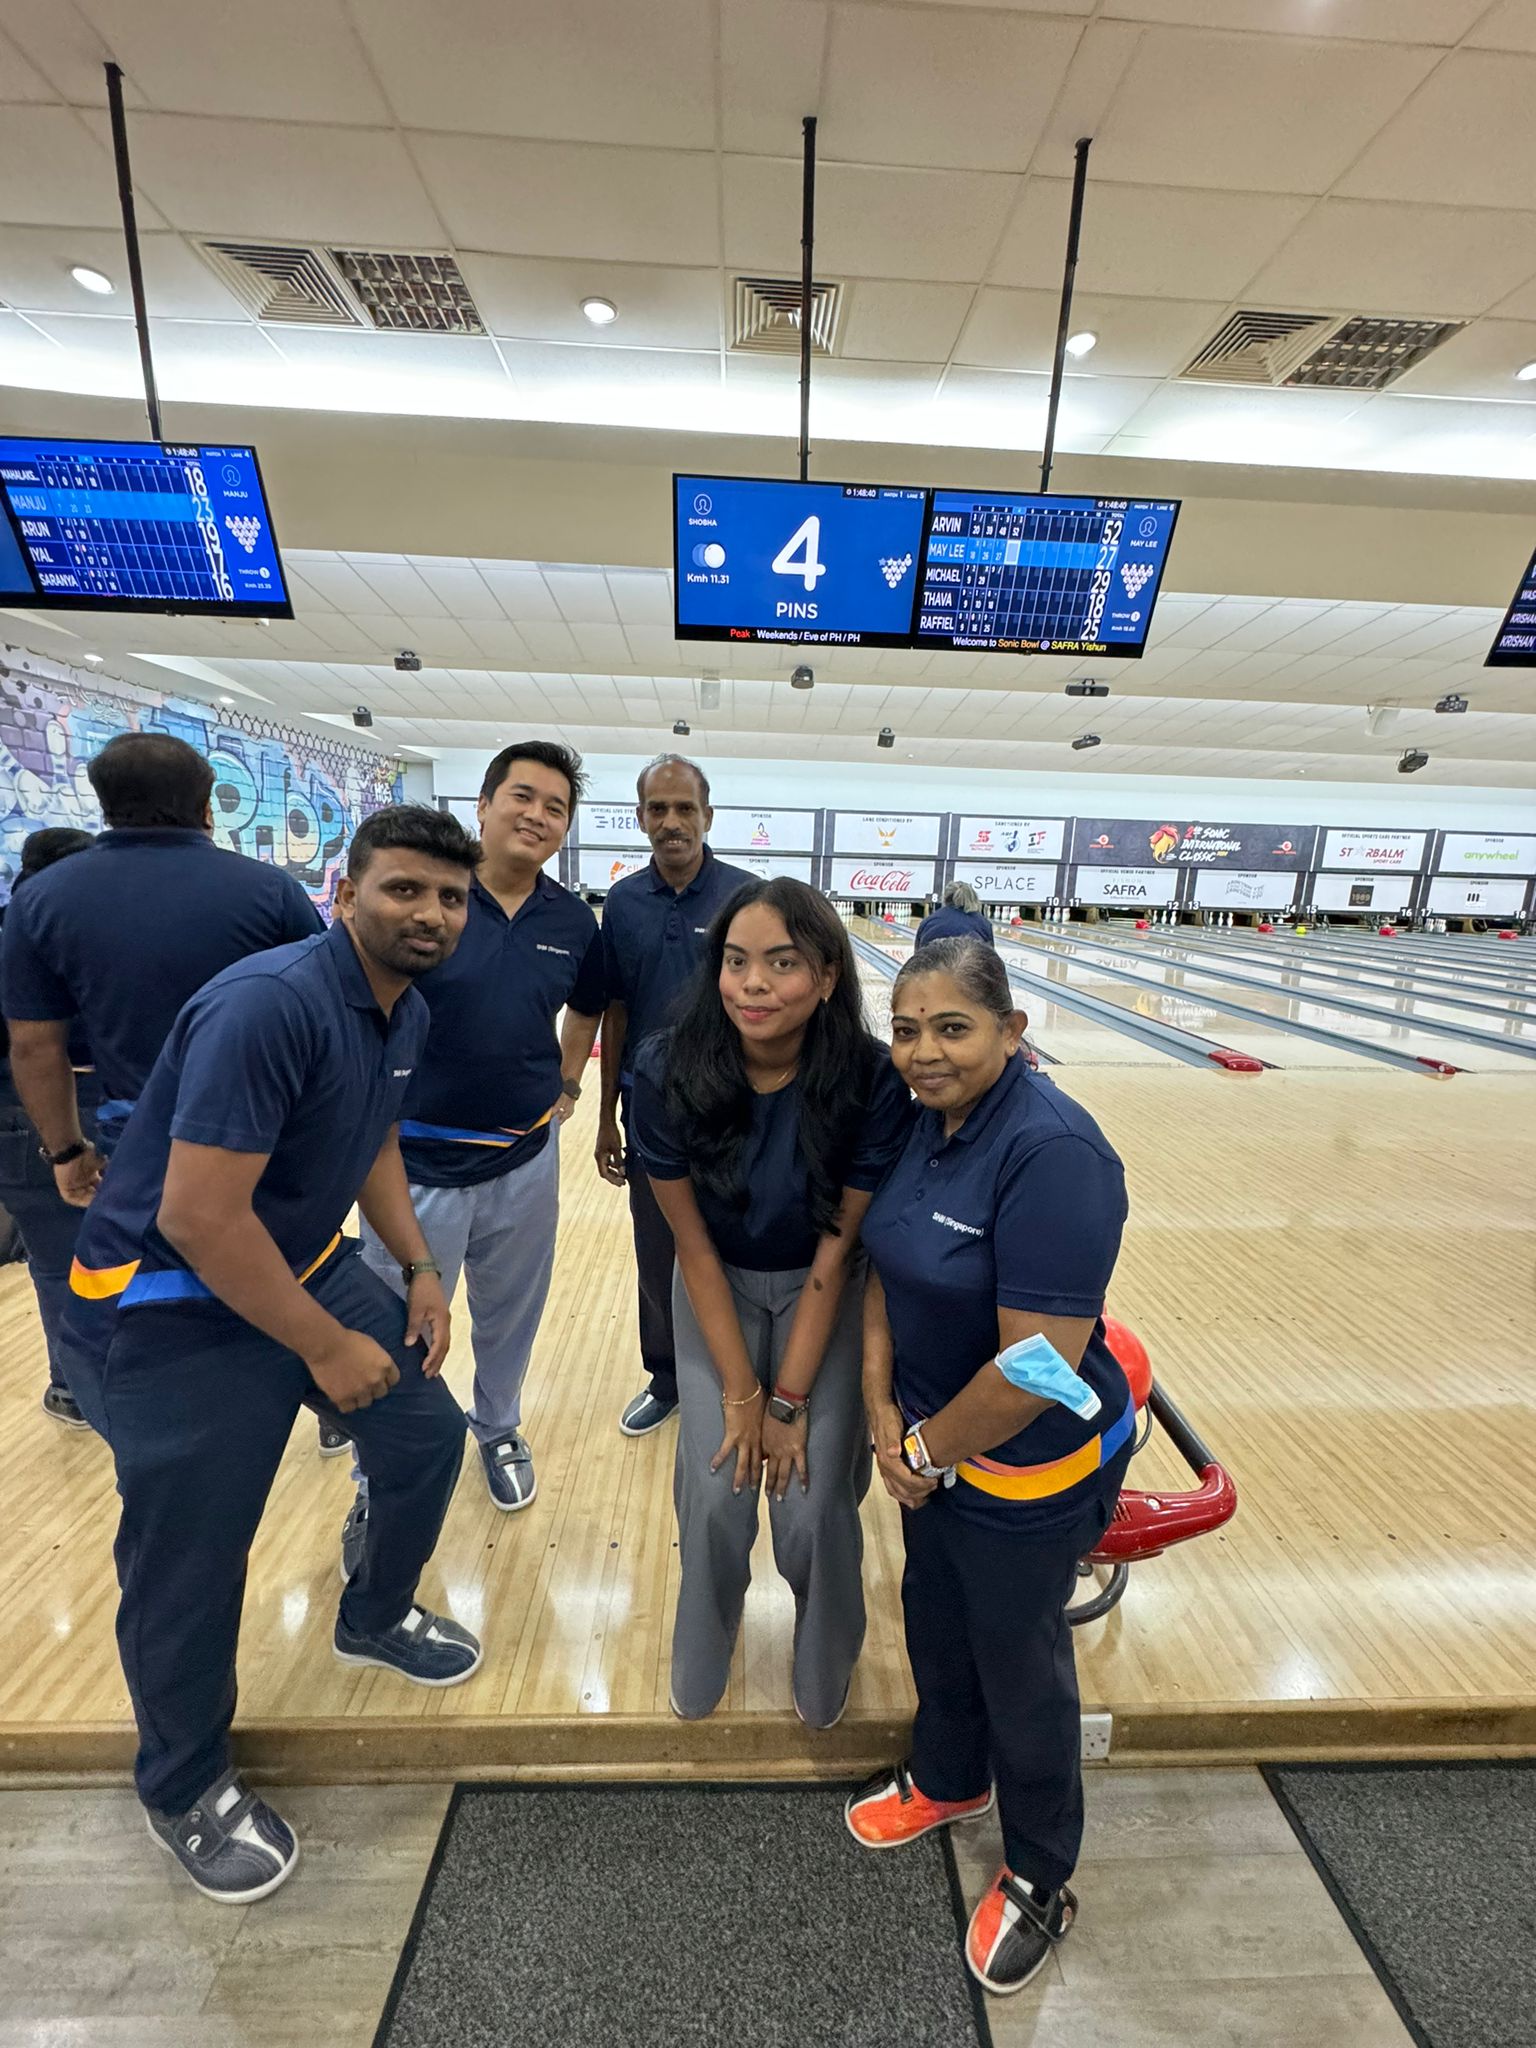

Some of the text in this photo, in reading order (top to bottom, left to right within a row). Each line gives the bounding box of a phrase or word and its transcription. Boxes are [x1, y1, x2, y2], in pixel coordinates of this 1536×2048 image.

[184, 467, 207, 497] 18
[223, 490, 248, 498] MANJU
[853, 488, 877, 497] 1:48:40
[919, 491, 925, 499] 5
[9, 494, 47, 511] MANJU
[192, 496, 214, 523] 23
[21, 520, 51, 537] ARUN
[688, 518, 718, 527] SHOBHA
[931, 516, 962, 533] ARVIN
[198, 522, 220, 549] 19
[1102, 520, 1123, 545] 52
[928, 543, 965, 558] MAY LEE
[1145, 540, 1158, 548] LEE
[771, 515, 827, 592] 4
[1096, 546, 1117, 570] 27
[206, 548, 224, 575] 17
[38, 572, 80, 587] SARANYA
[687, 573, 730, 584] Kmh 11.31
[925, 568, 961, 583] MICHAEL
[1090, 570, 1111, 594] 29
[212, 573, 234, 601] 16
[924, 591, 952, 607] THAVA
[1088, 593, 1106, 619] 18
[776, 602, 818, 619] PINS
[919, 615, 954, 630] RAFFIEL
[1080, 618, 1101, 641] 25
[730, 628, 750, 638] Peak
[757, 630, 798, 640] Weekends
[804, 632, 820, 641] Eve
[820, 632, 828, 641] of
[829, 633, 842, 642] PH
[847, 633, 860, 642] PH
[952, 636, 1107, 652] Welcome to Sonic Bowl @ SAFRA Yishun
[1201, 827, 1230, 839] SONIC
[1179, 850, 1216, 862] CLASSIC
[1464, 848, 1519, 860] anywheel
[573, 882, 580, 892] 3
[974, 876, 1036, 891] SPLACE
[1103, 884, 1147, 896] SAFRA
[932, 893, 938, 903] 8
[1047, 897, 1059, 906] 10
[1069, 898, 1080, 907] 11
[1167, 901, 1179, 910] 12
[1188, 901, 1200, 910] 13
[1285, 905, 1297, 914] 14
[1306, 905, 1318, 914] 15
[1401, 908, 1412, 917] 16
[1420, 908, 1432, 917] 17
[1515, 910, 1526, 919] 18
